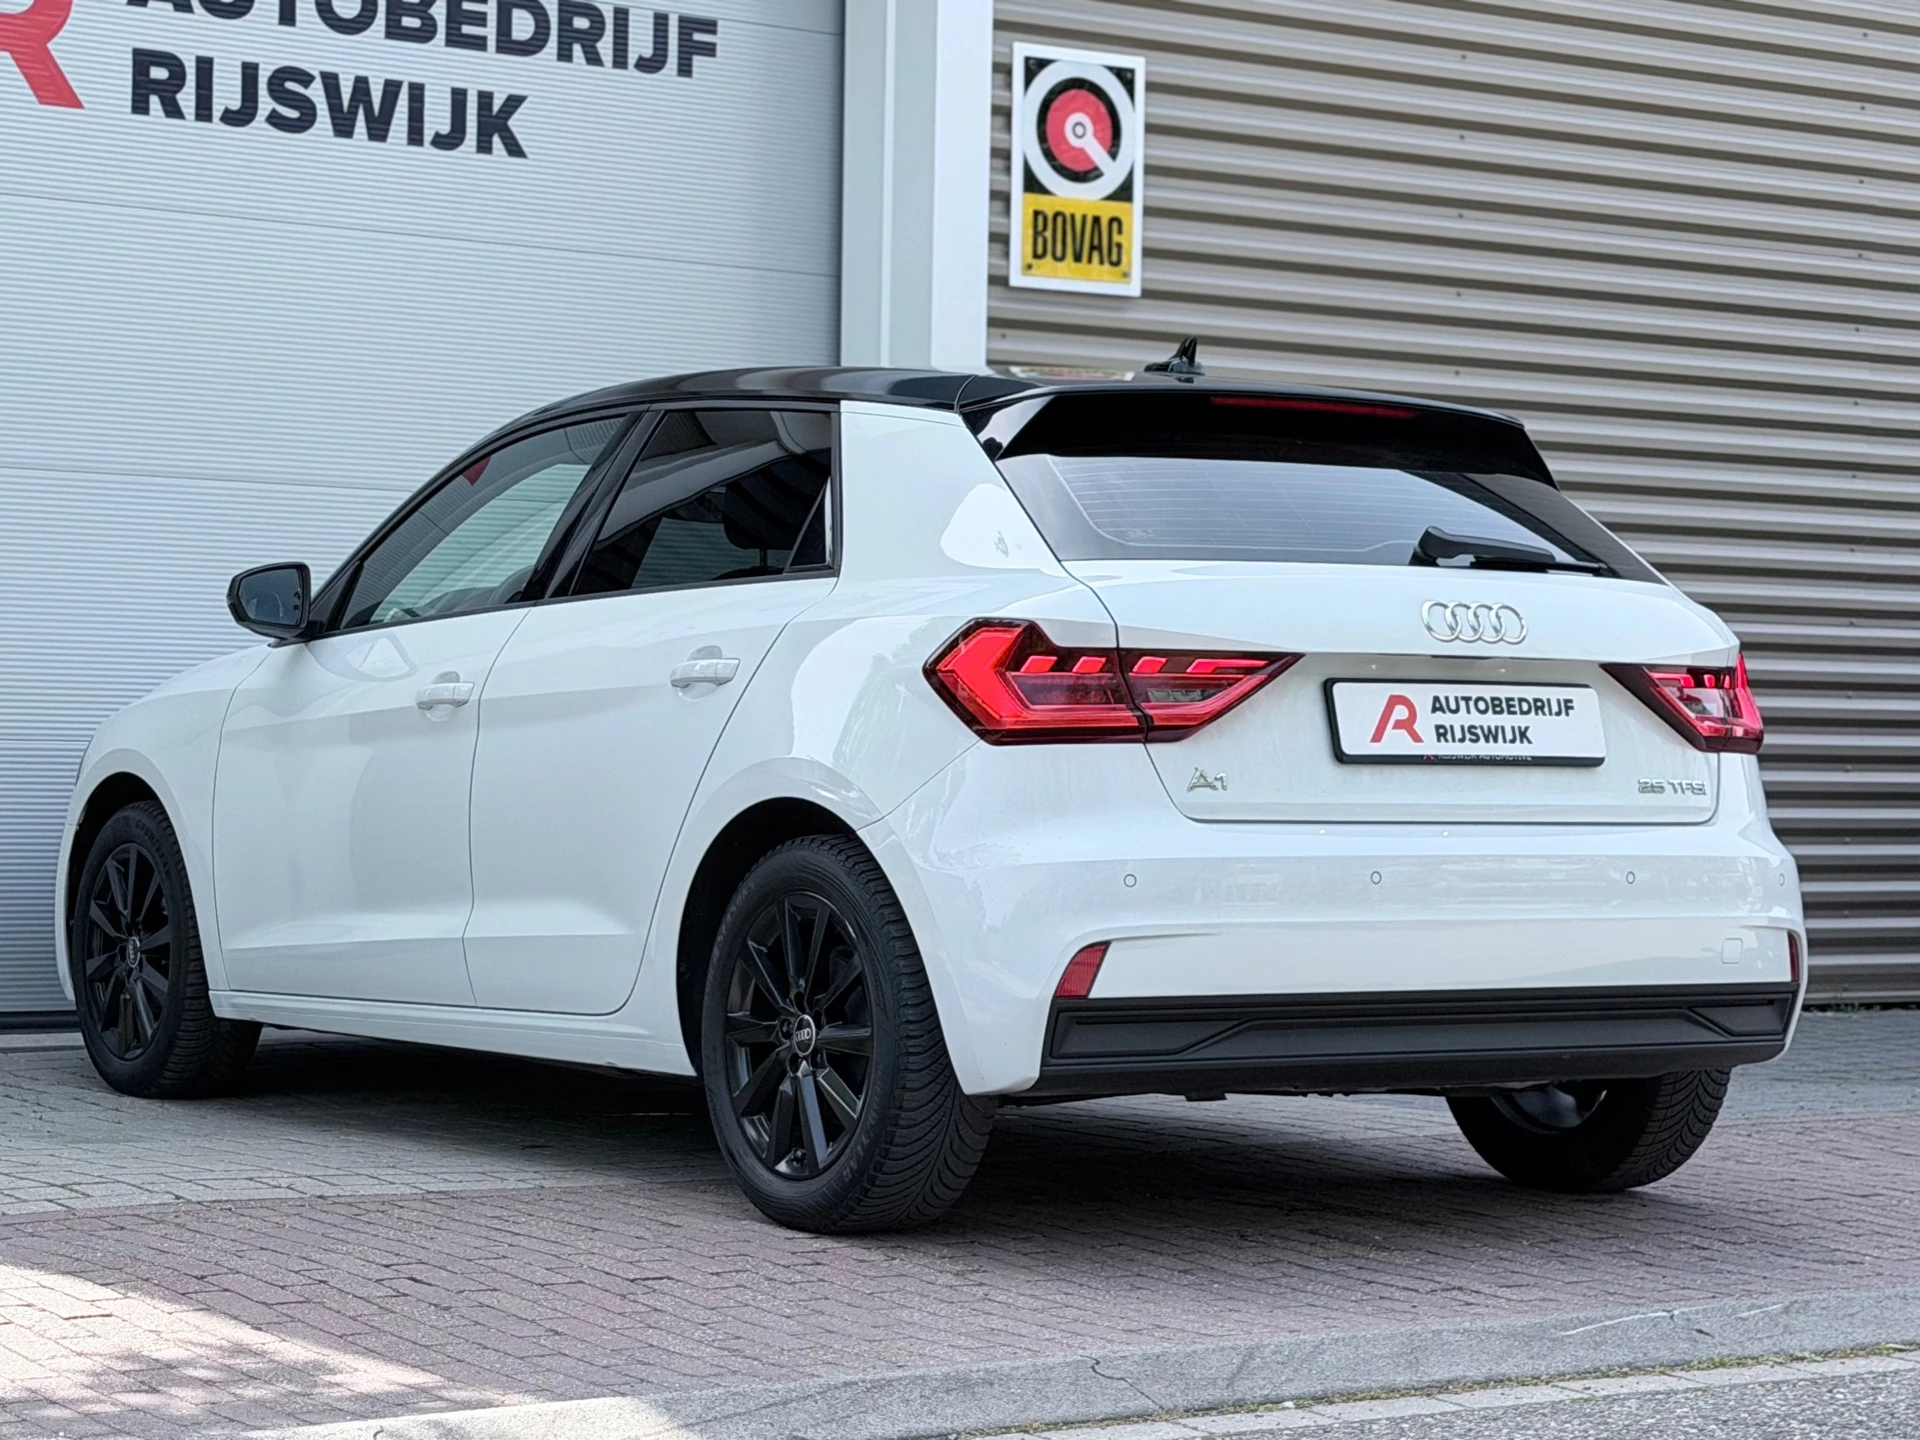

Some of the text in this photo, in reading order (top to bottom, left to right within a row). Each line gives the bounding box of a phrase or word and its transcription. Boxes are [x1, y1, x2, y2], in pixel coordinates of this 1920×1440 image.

[126, 0, 718, 78] OBEDRIJF
[130, 47, 529, 159] RIJSWIJK
[1031, 209, 1124, 268] BOVAG
[1430, 695, 1575, 717] AUTOBEDRIJF
[1434, 724, 1533, 745] RIJSWIJK
[1186, 766, 1228, 792] A1
[1637, 778, 1666, 794] 25
